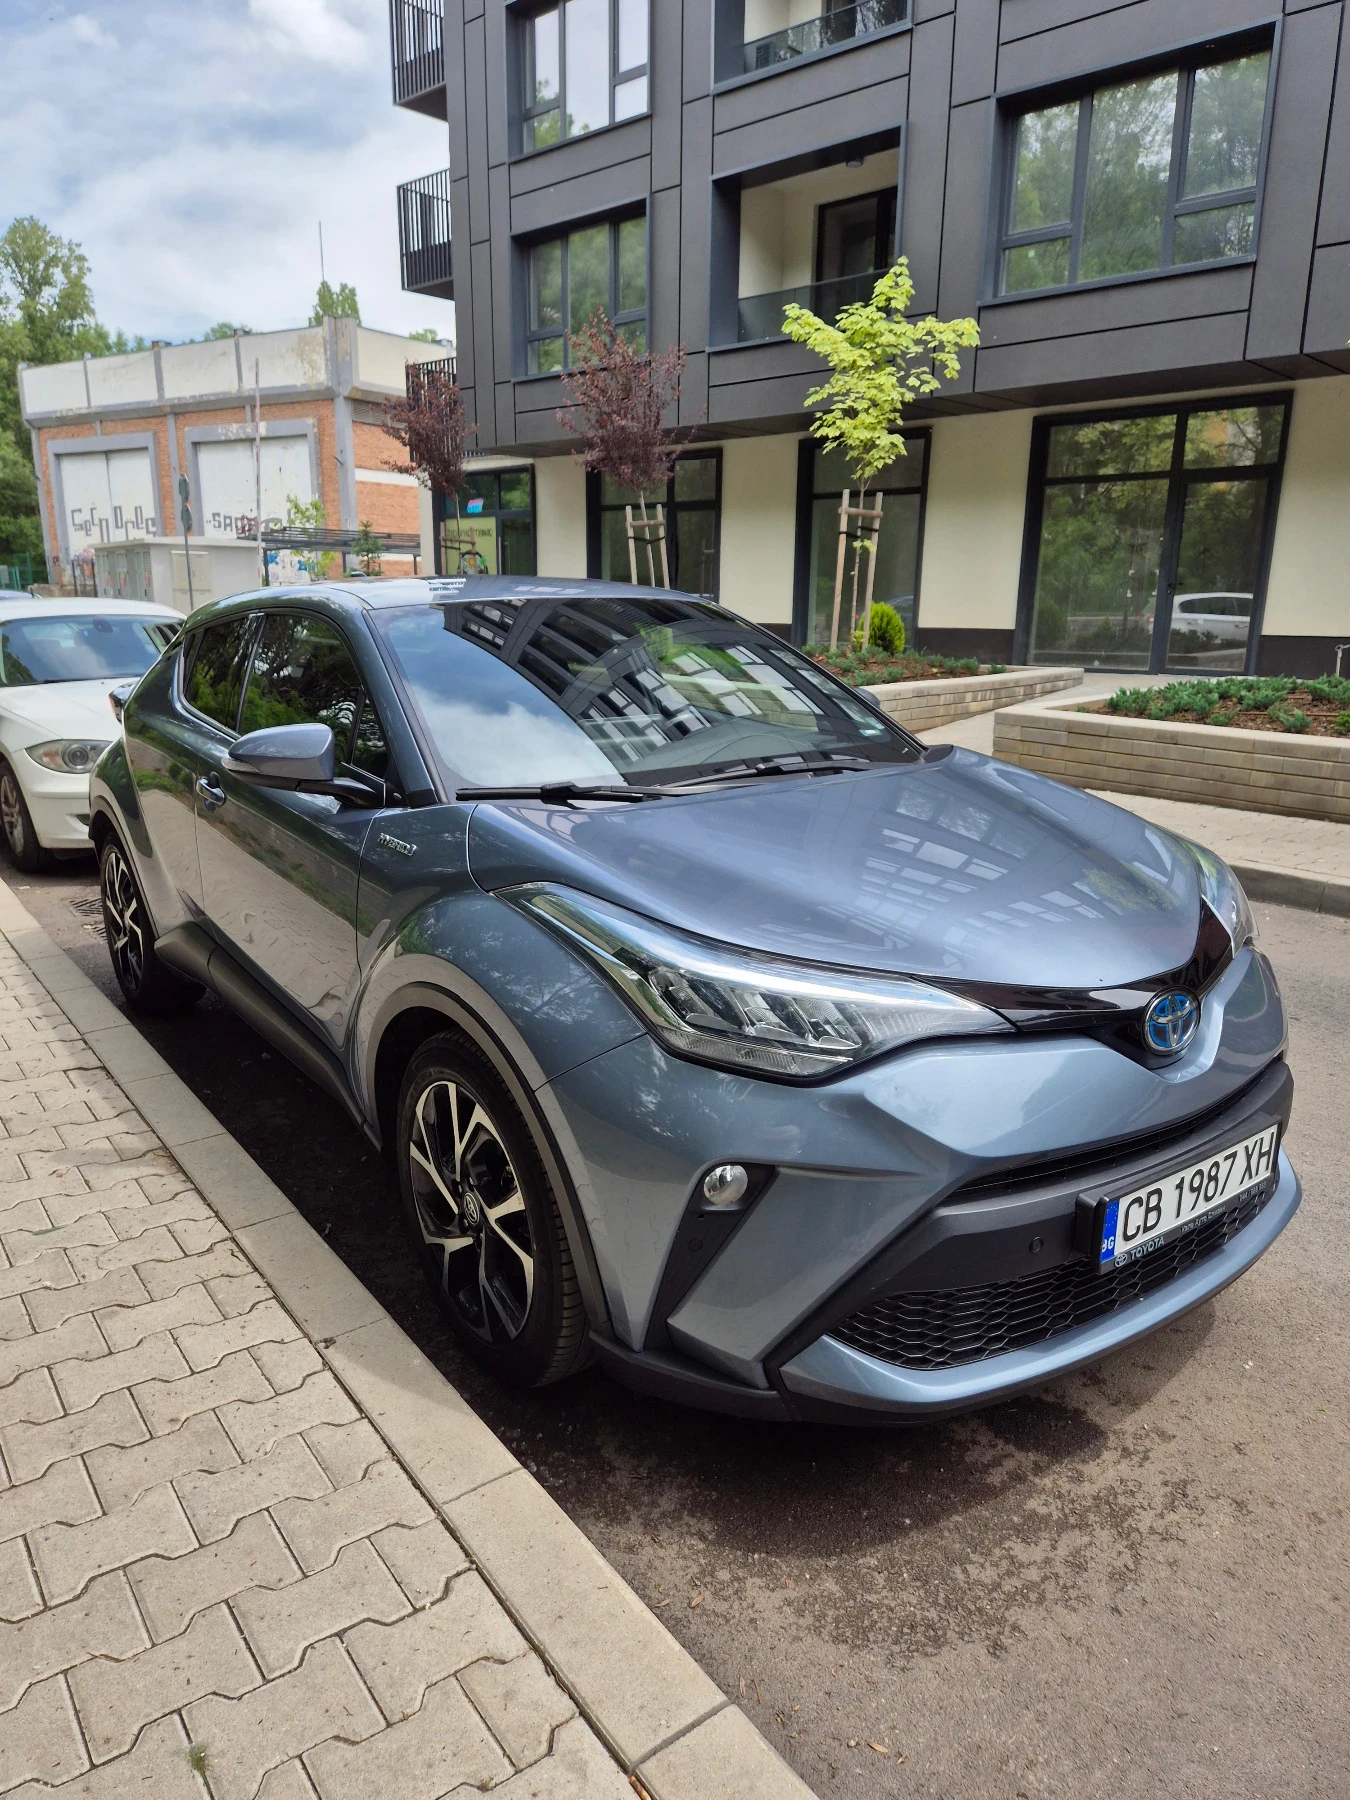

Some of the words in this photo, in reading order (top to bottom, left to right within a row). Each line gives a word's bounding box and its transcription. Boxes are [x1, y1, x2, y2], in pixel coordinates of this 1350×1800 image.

[1122, 1186, 1163, 1242] CB
[1174, 1150, 1238, 1219] 1987
[1239, 1131, 1275, 1187] XH
[1130, 1236, 1165, 1260] TOYOTA
